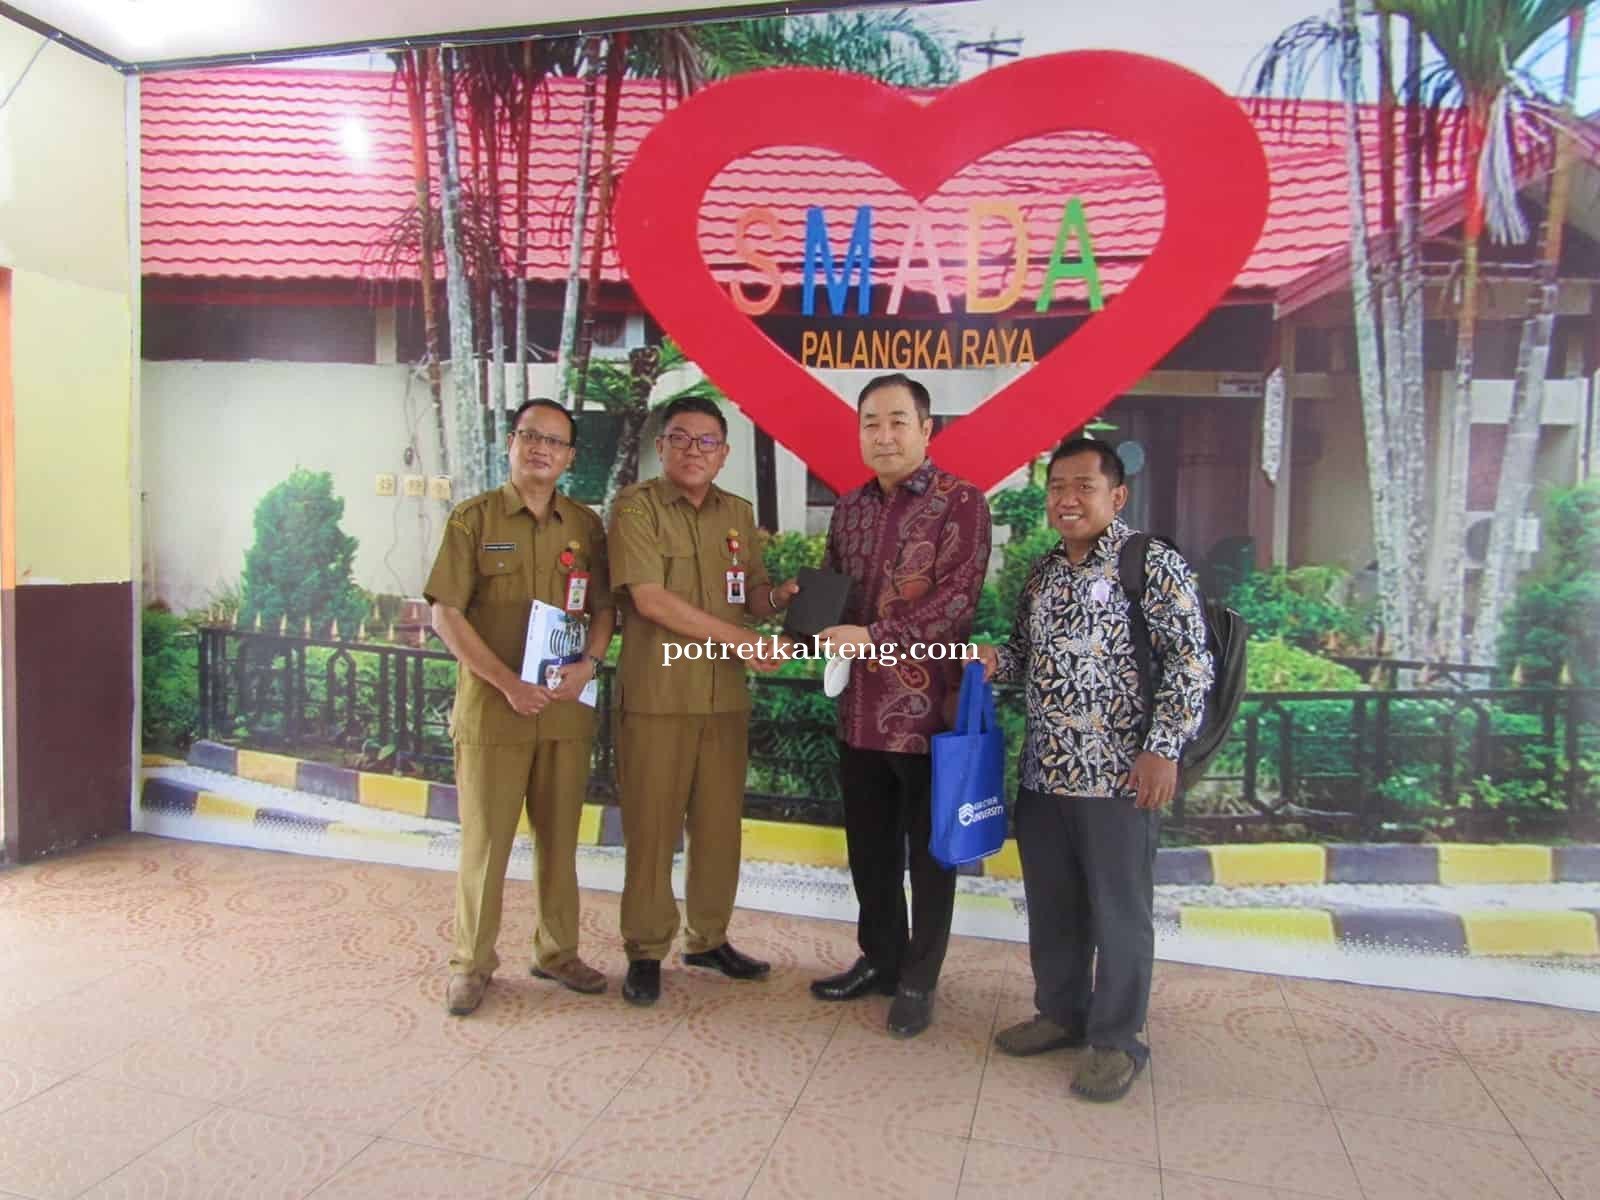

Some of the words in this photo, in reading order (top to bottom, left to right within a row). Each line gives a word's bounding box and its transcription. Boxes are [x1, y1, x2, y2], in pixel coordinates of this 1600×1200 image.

[731, 198, 1104, 316] SMADA
[802, 330, 952, 368] PALANGKA
[961, 328, 1037, 367] RAYA
